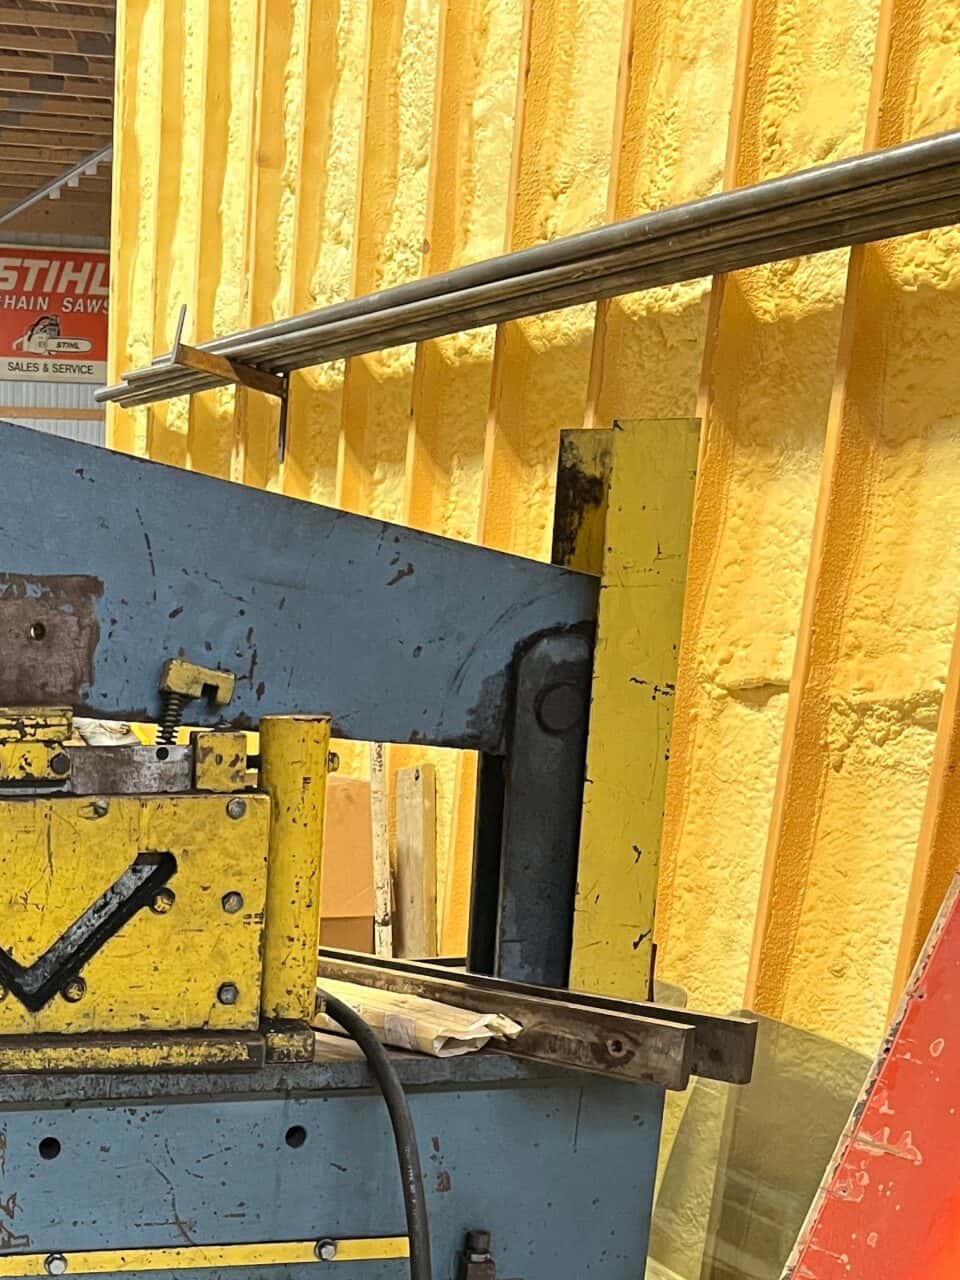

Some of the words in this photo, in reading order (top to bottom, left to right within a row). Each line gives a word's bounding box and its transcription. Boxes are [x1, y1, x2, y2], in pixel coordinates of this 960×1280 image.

[8, 361, 39, 373] SALES
[43, 364, 49, 373] &
[52, 363, 94, 375] SERVICE
